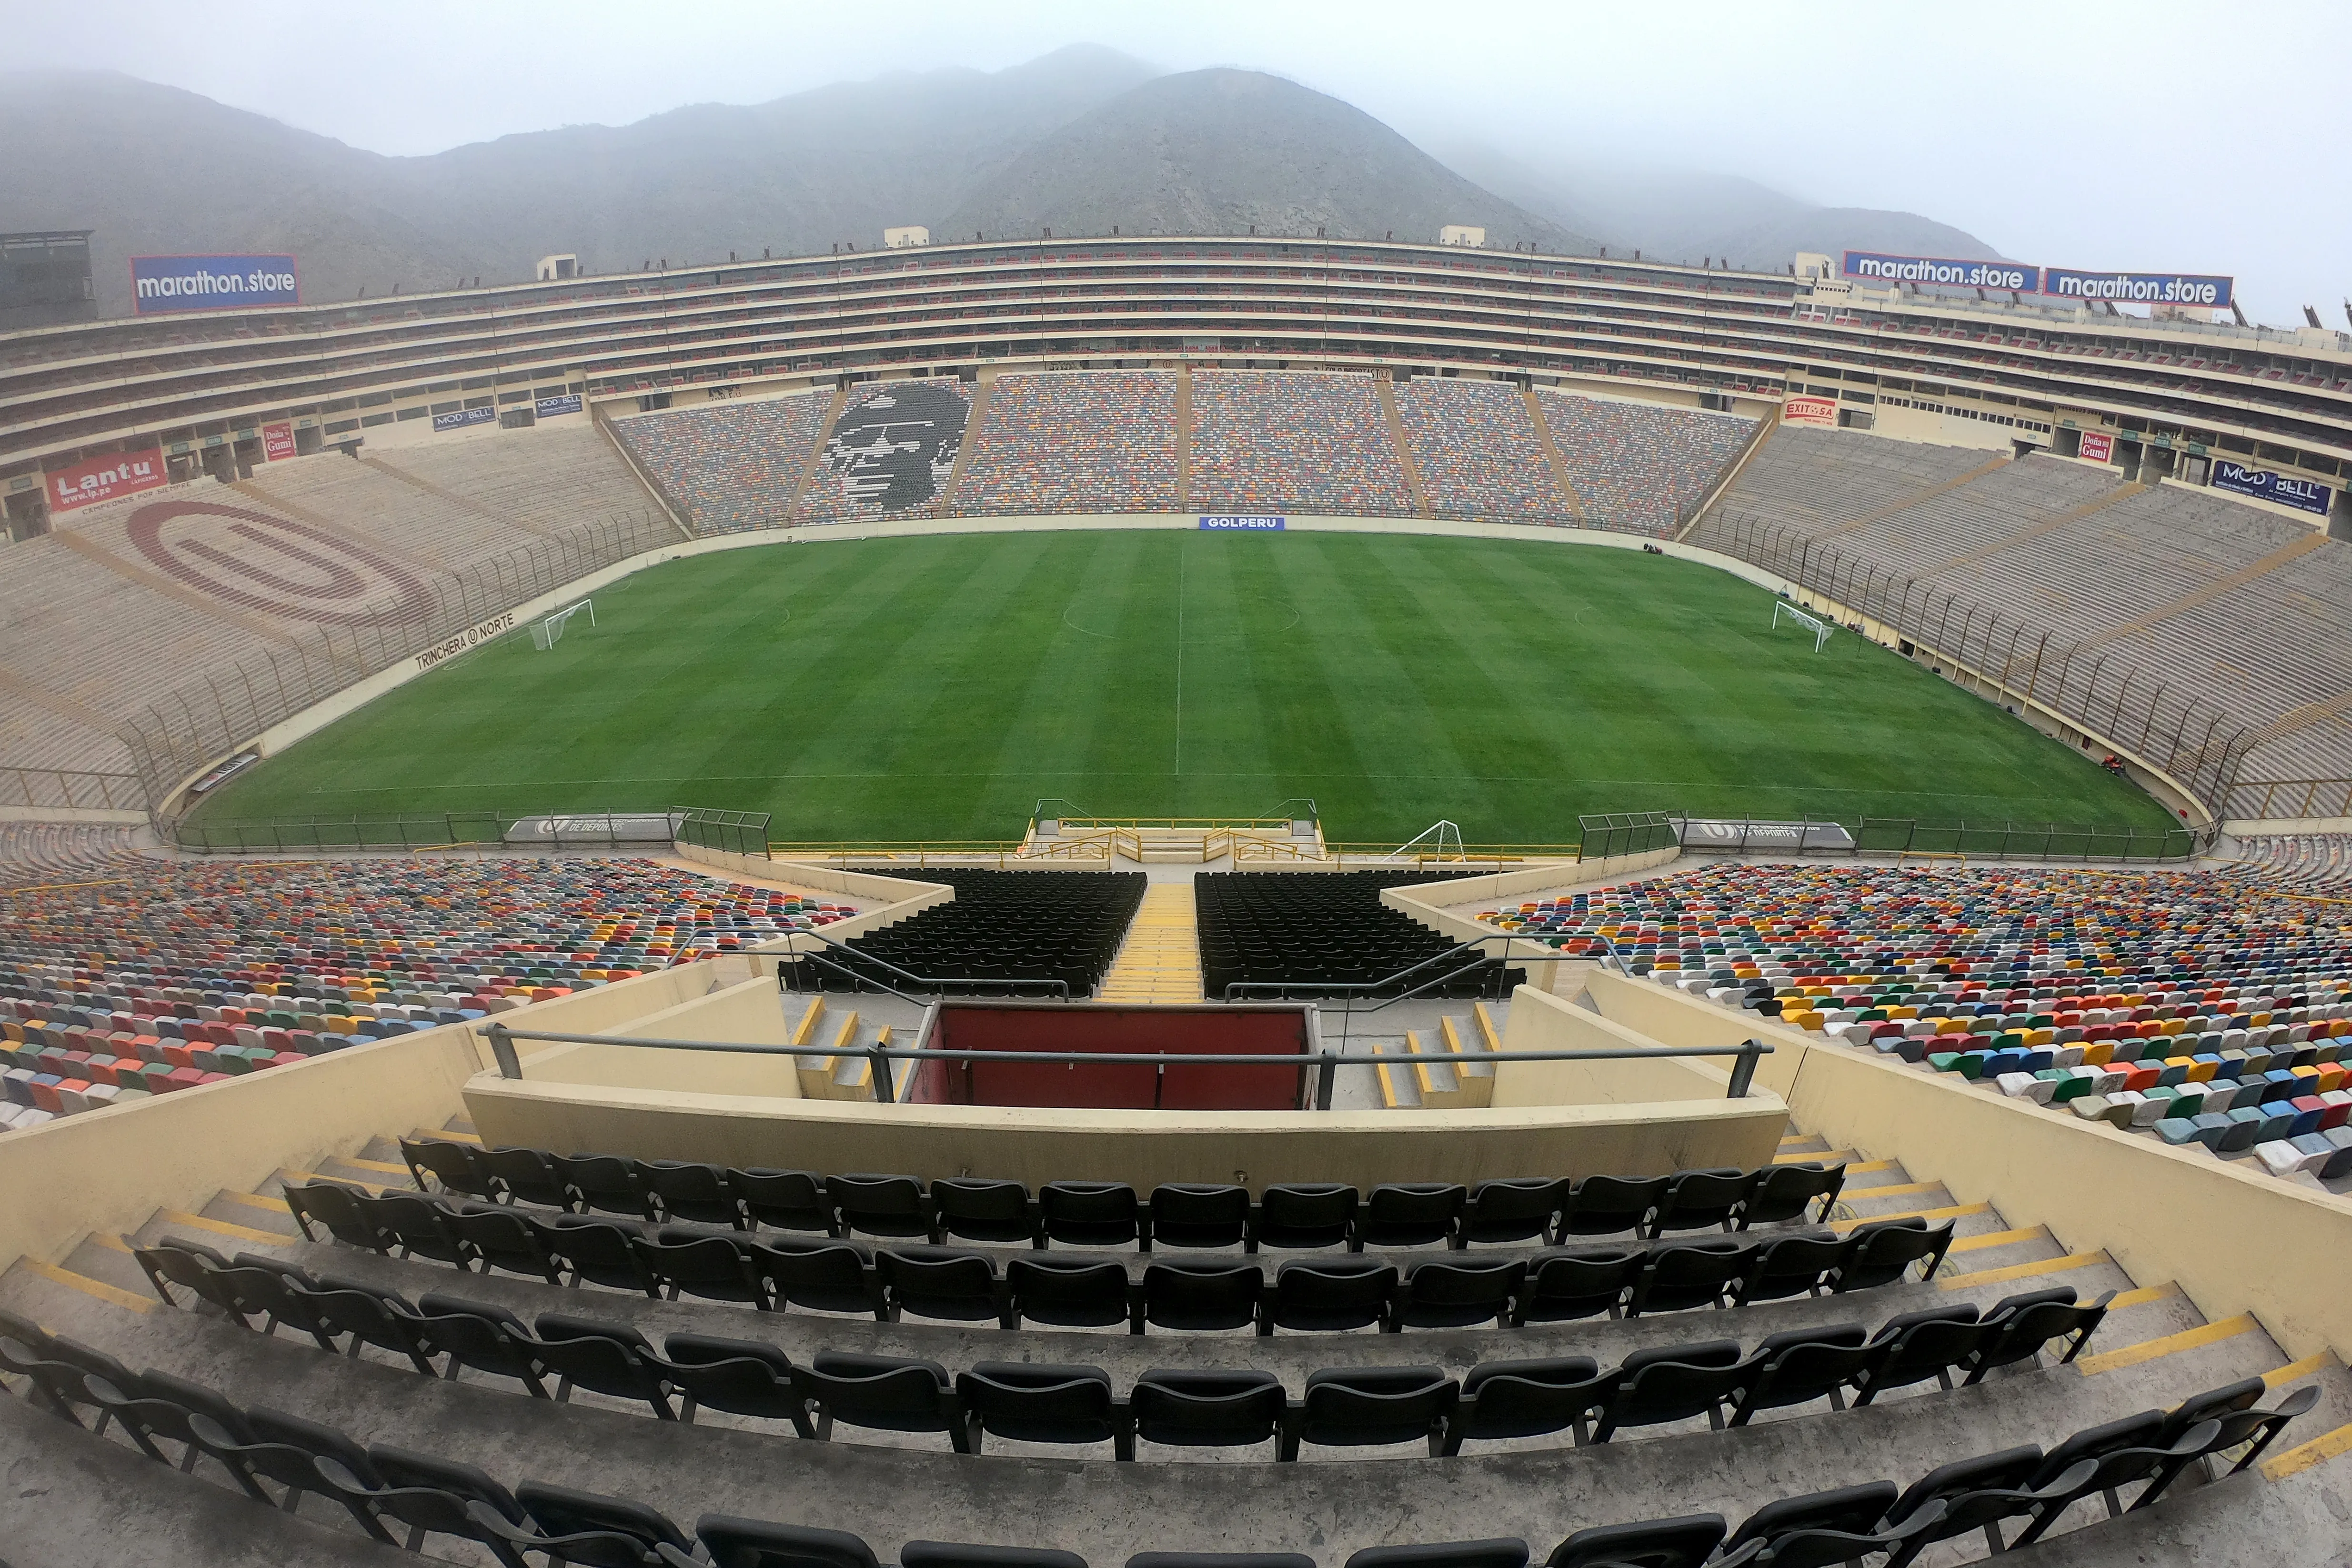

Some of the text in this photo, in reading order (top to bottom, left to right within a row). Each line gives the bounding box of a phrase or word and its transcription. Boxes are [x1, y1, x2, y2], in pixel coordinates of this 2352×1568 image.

[1859, 259, 2024, 289] marathon.store
[137, 269, 295, 298] marathon.store
[2059, 275, 2217, 303] marathon.store
[537, 396, 581, 408] MOD BELL
[437, 409, 492, 425] MOD BELL
[267, 437, 291, 452] Gumi
[2084, 435, 2101, 446] Doña
[2082, 446, 2107, 459] Gumi
[57, 462, 151, 496] Lantu
[1208, 518, 1276, 527] GOLPERU
[415, 635, 467, 670] TRINCHERA
[479, 613, 514, 639] NORTE
[569, 823, 583, 831] DE
